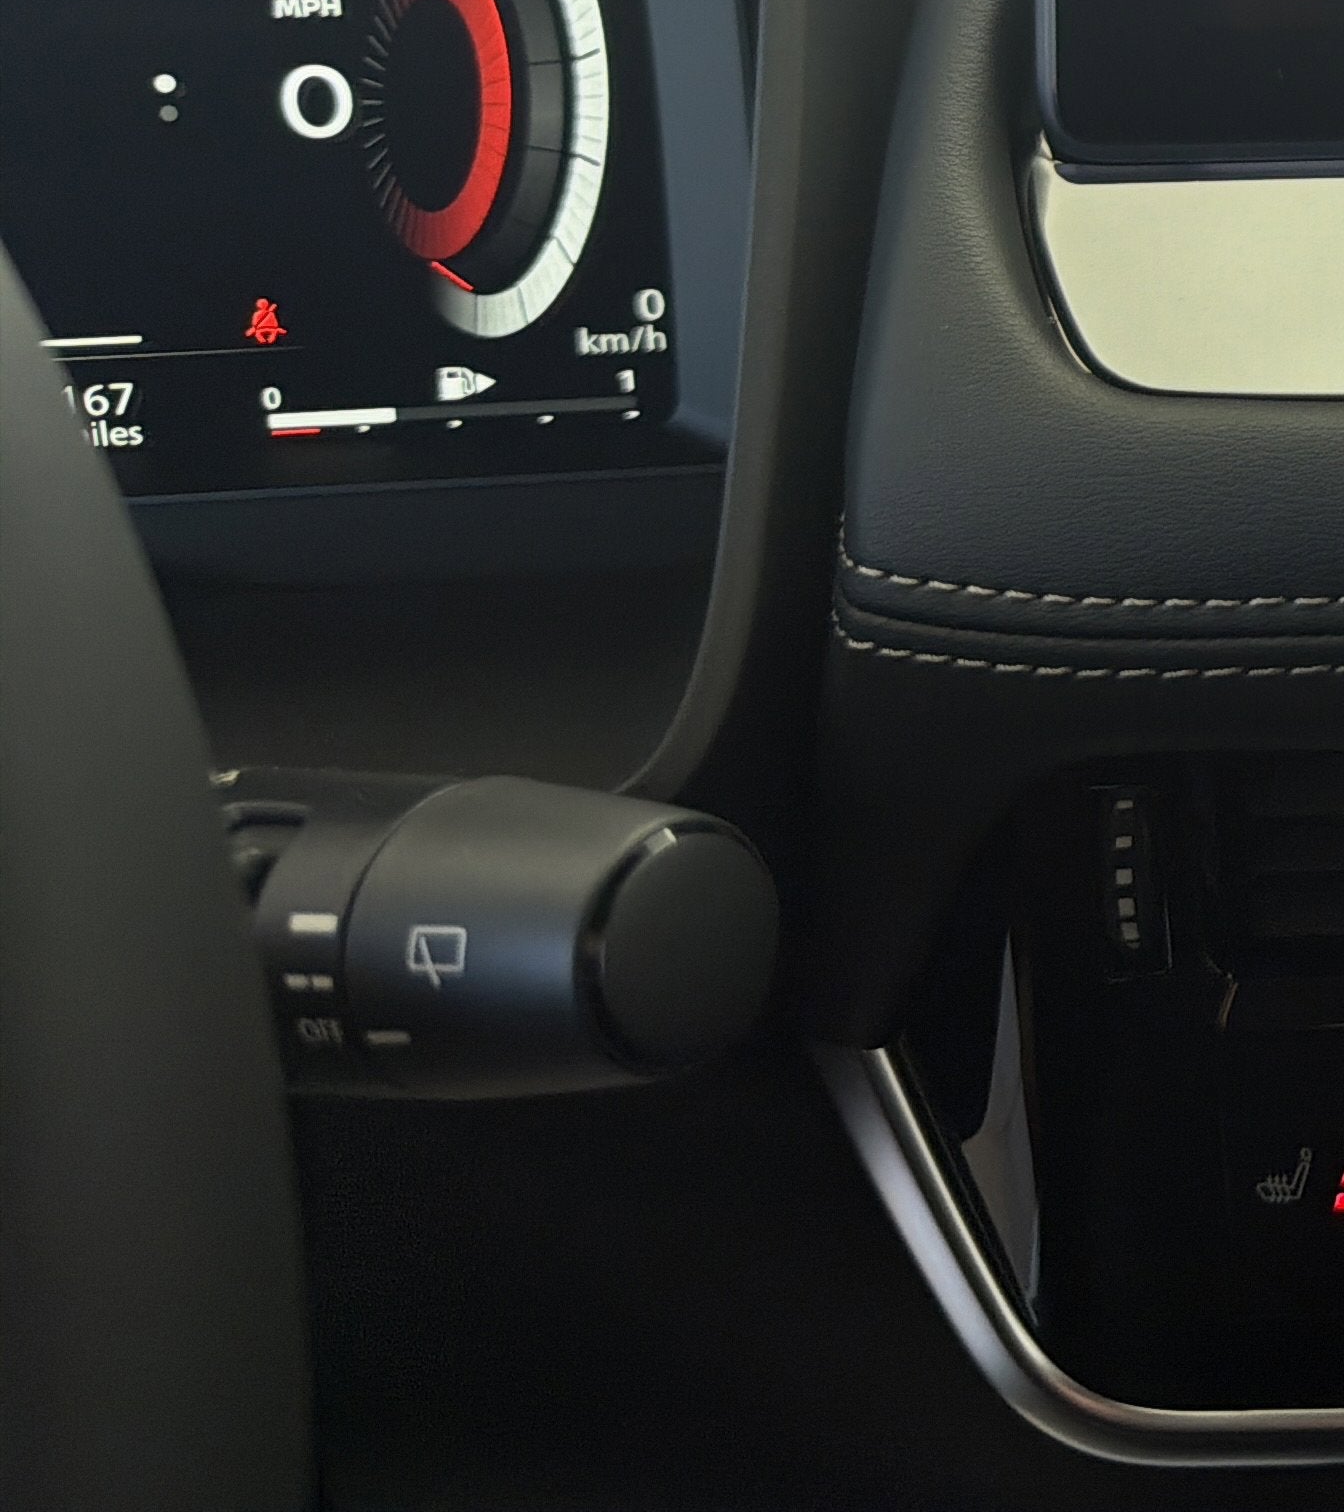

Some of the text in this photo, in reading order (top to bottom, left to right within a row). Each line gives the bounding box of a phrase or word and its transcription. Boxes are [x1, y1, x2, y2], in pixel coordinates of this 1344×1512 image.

[279, 63, 354, 139] 0
[633, 288, 666, 321] 0
[576, 325, 668, 357] km/h
[615, 369, 637, 392] 1
[261, 386, 283, 410] 0
[80, 419, 145, 448] iles
